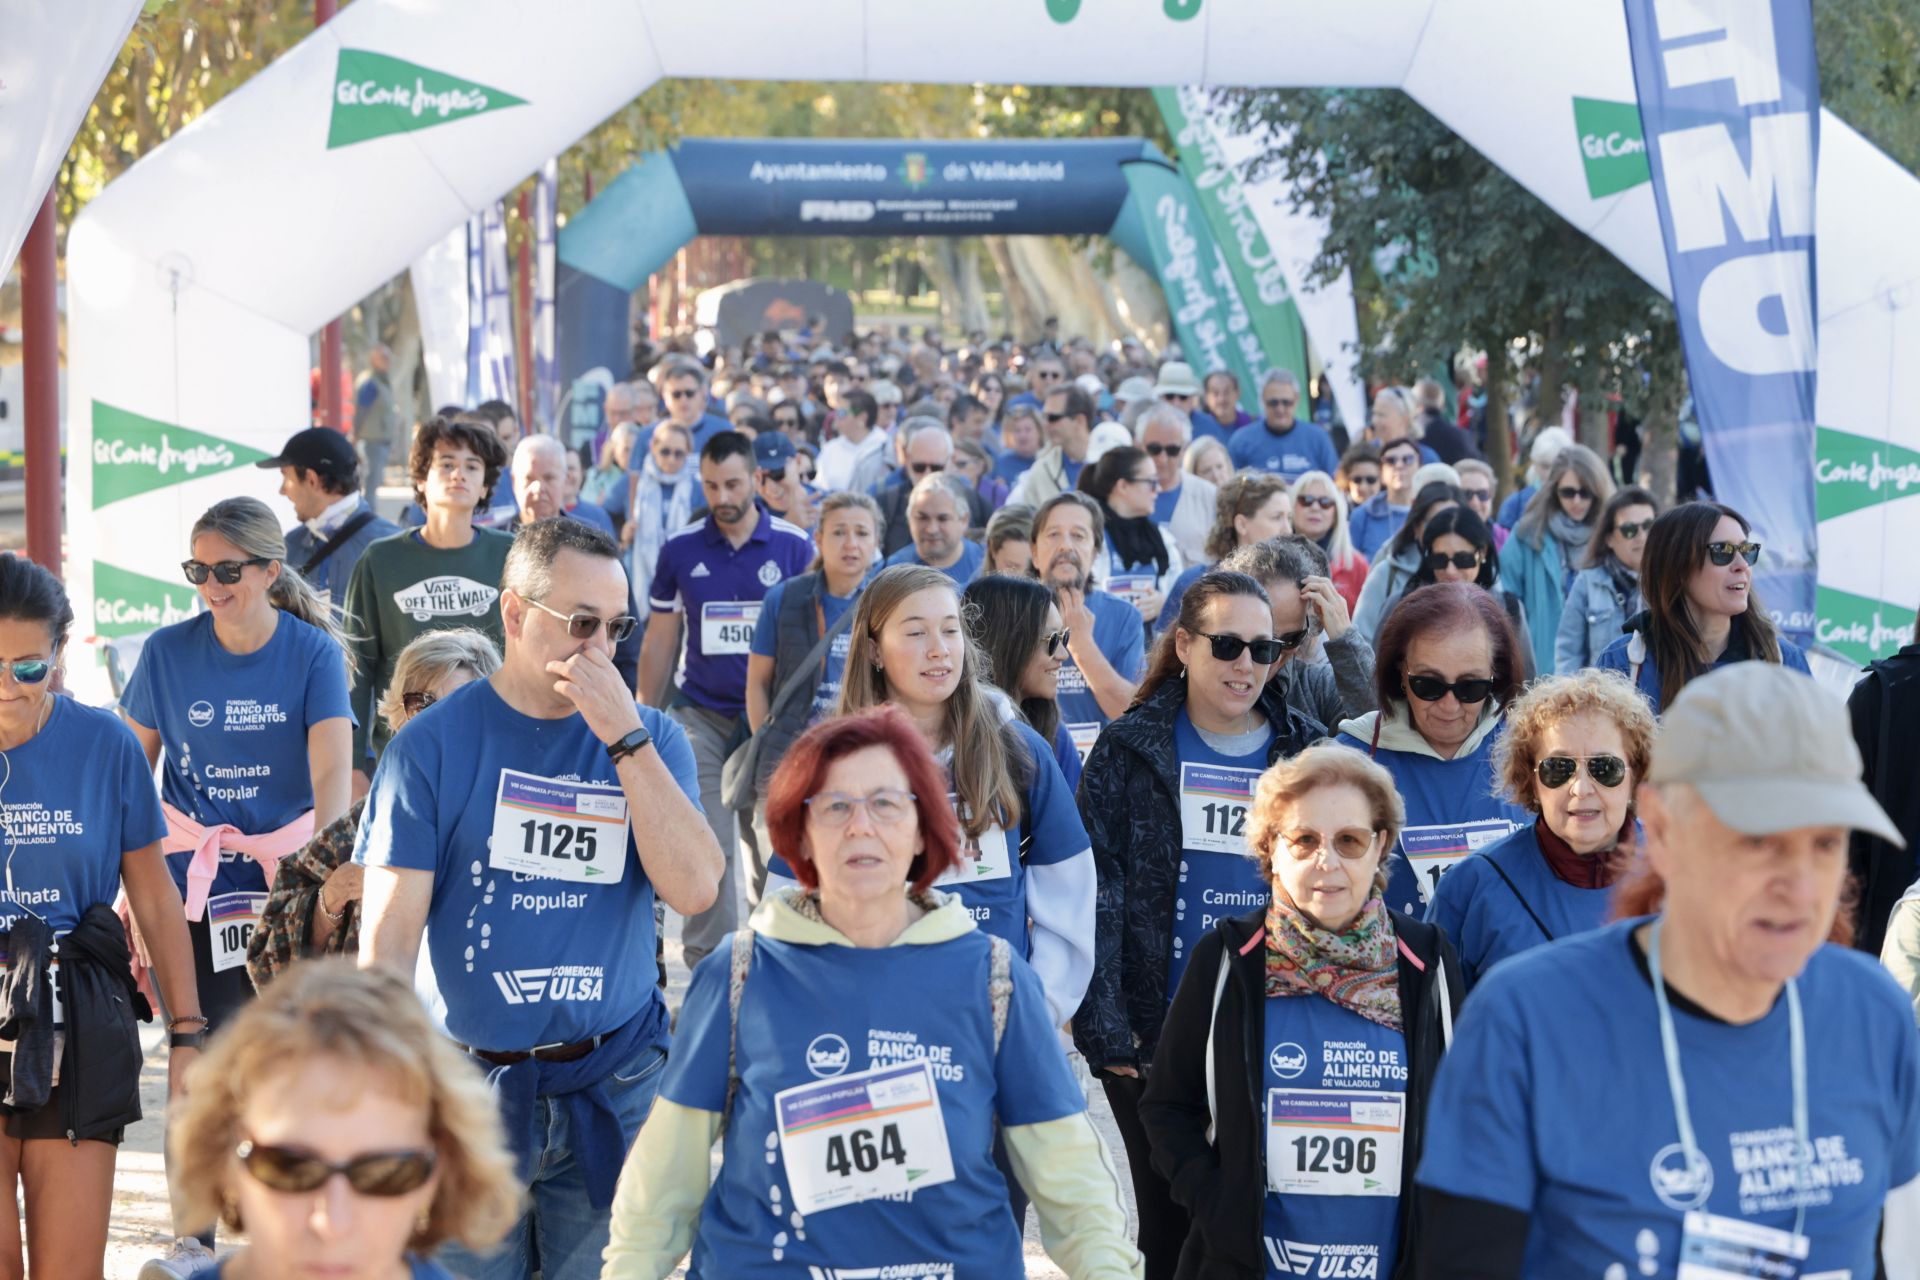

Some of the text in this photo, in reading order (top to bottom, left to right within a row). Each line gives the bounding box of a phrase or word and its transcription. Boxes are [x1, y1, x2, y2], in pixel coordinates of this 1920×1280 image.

[337, 76, 488, 117] El Corte Inglés
[750, 160, 1065, 184] Ayuntamiento de Valladolid
[94, 433, 235, 474] El Corte Inglés
[1816, 459, 1867, 484] Corte
[429, 594, 455, 610] THE
[95, 597, 112, 624] El
[112, 598, 160, 625] Corte
[1817, 618, 1867, 643] Corte
[225, 704, 278, 715] BANCO DE
[225, 712, 287, 724] ALIMENTOS
[205, 764, 271, 779] Caminata
[519, 784, 547, 794] CAMINATA
[547, 790, 574, 799] POPULAR
[5, 810, 72, 823] BANCO DE
[5, 823, 83, 836] ALIMENTOS
[520, 819, 597, 861] 1125
[511, 891, 588, 915] Popular
[551, 966, 603, 977] COMERCIAL
[549, 977, 604, 1001] ULSA
[868, 1029, 917, 1042] FUNDACIÓN
[868, 1040, 952, 1063] BANCO DE
[1323, 1041, 1366, 1049] FUNDACIÓN
[1323, 1050, 1398, 1064] BANCO DE
[1323, 1064, 1408, 1080] ALIMENTOS
[1322, 1079, 1380, 1088] DE VALLADOLID
[826, 1123, 907, 1177] 464
[1291, 1135, 1377, 1174] 1296
[1320, 1245, 1379, 1256] COMERCIAL
[880, 1262, 954, 1280] COMERCIAL
[1318, 1256, 1378, 1280] ULSA
